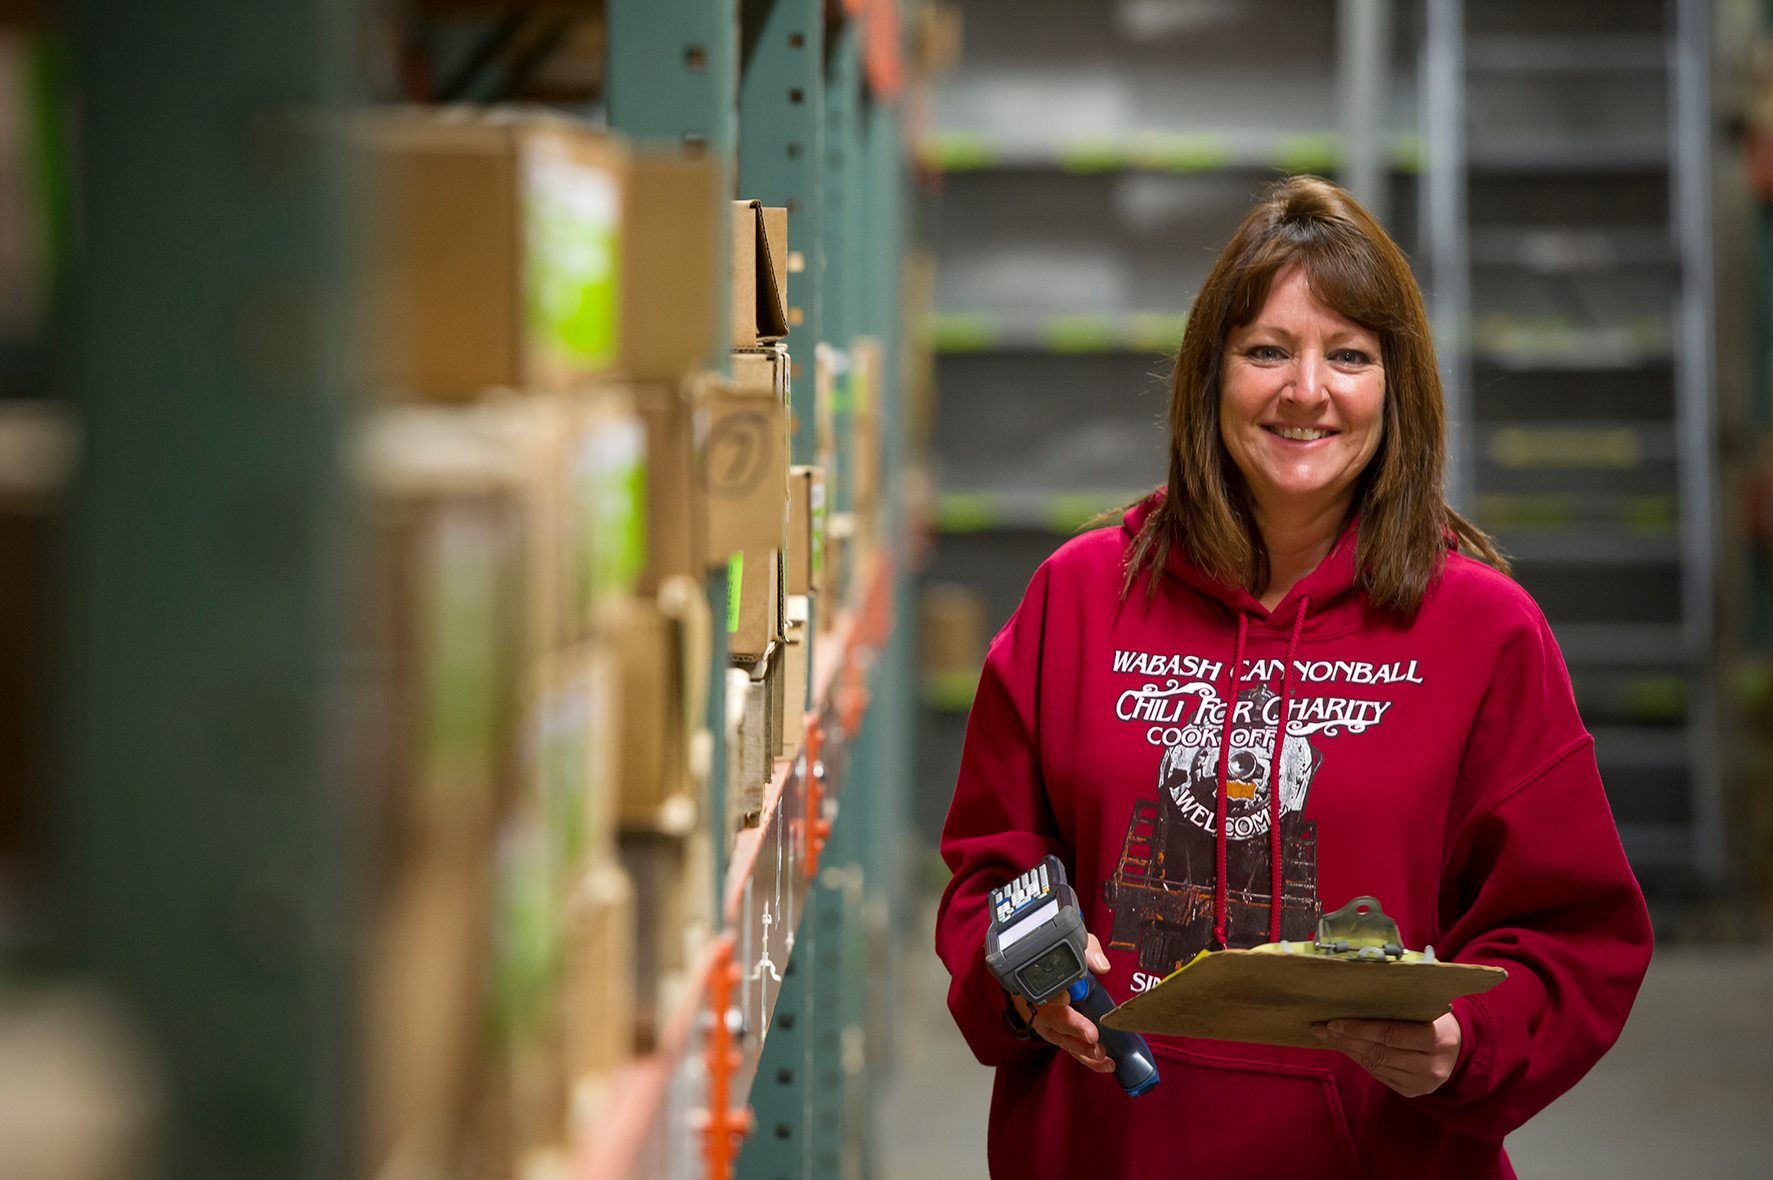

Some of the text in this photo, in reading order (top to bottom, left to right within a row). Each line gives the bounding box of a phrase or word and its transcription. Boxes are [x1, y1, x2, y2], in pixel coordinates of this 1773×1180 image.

[1113, 650, 1222, 681] WABASH
[1116, 684, 1391, 730] CHILI FOR CHARITY
[1146, 726, 1277, 748] COOK OFF
[1175, 789, 1289, 836] WELCOM
